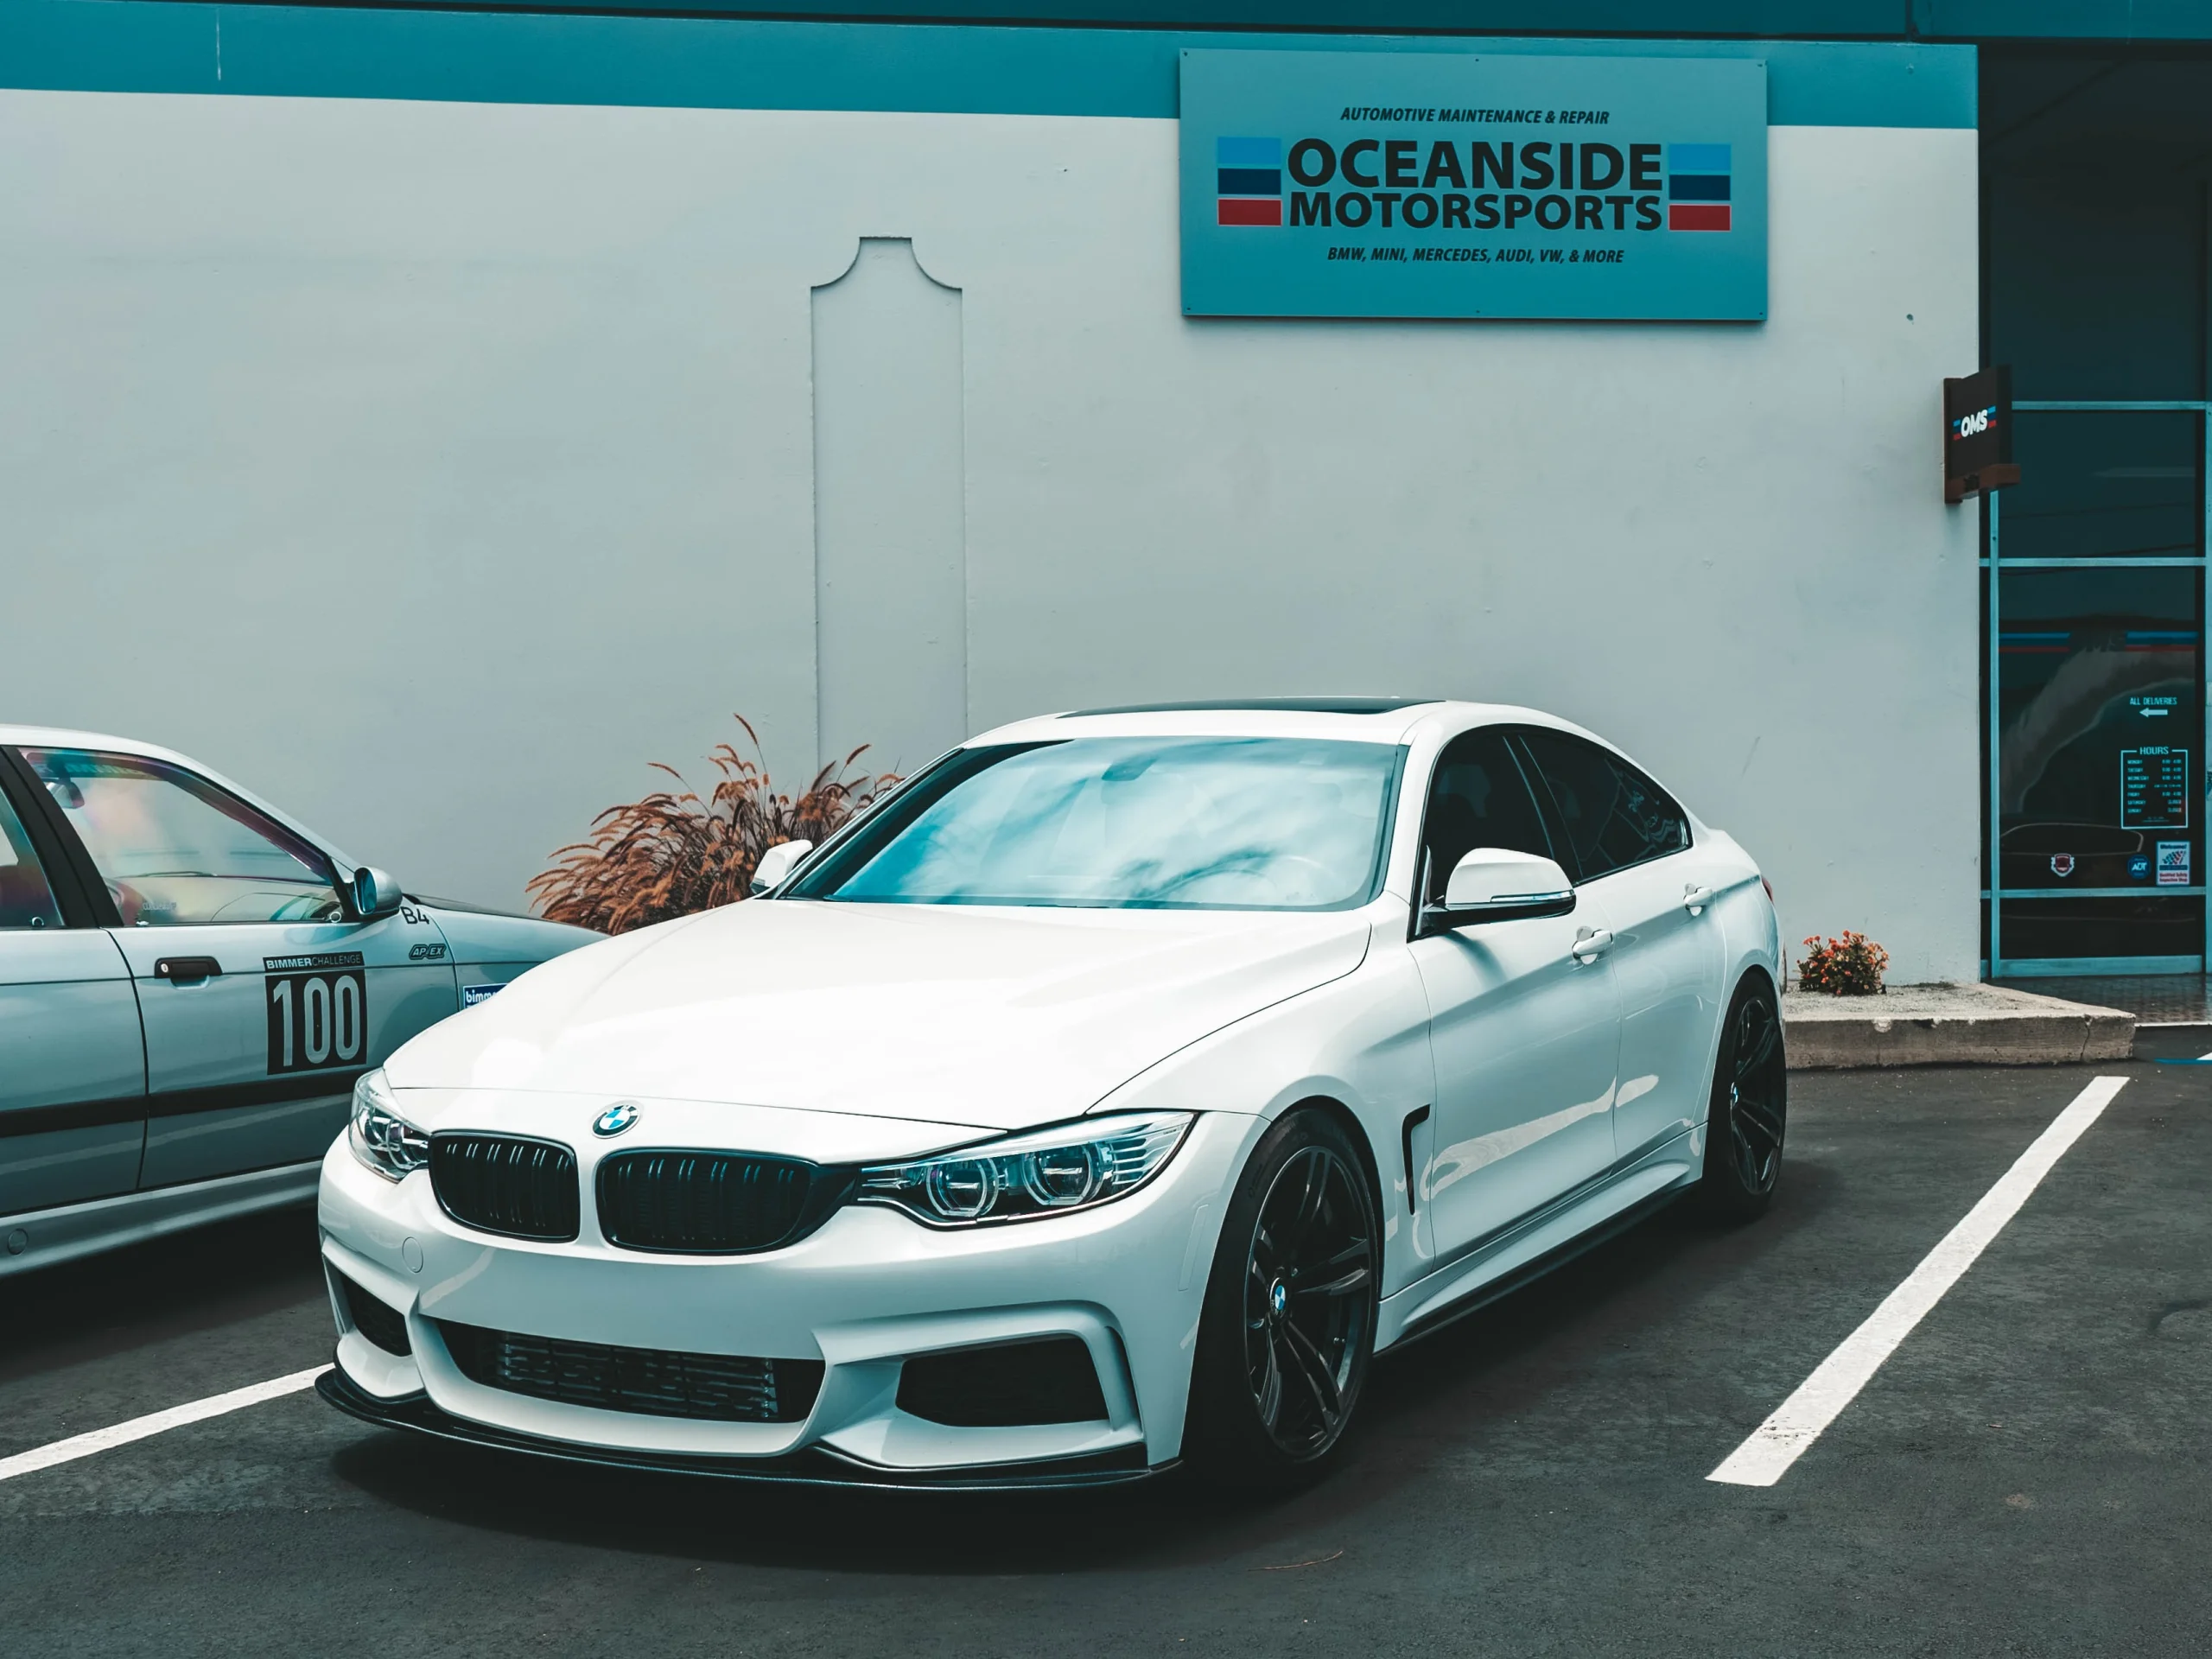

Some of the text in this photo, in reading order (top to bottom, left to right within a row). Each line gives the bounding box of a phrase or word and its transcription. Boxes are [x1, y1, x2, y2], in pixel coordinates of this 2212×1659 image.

[1340, 106, 1610, 124] AUTOMOTIVE MAINTENANCE & REPAIR
[1287, 137, 1662, 191] OCEANSIDE
[1290, 191, 1662, 231] MOTORSPORTS
[1327, 246, 1624, 264] BMW, MINI, MERCEDES, AUDI, VW, & MORE
[1961, 410, 1988, 437] OMS
[2129, 696, 2177, 705] ALL DELIVERIES
[2139, 746, 2169, 754] HOURS
[2131, 861, 2147, 871] ADT
[400, 906, 430, 925] B4
[465, 988, 497, 1003] bimm
[273, 975, 360, 1067] 100
